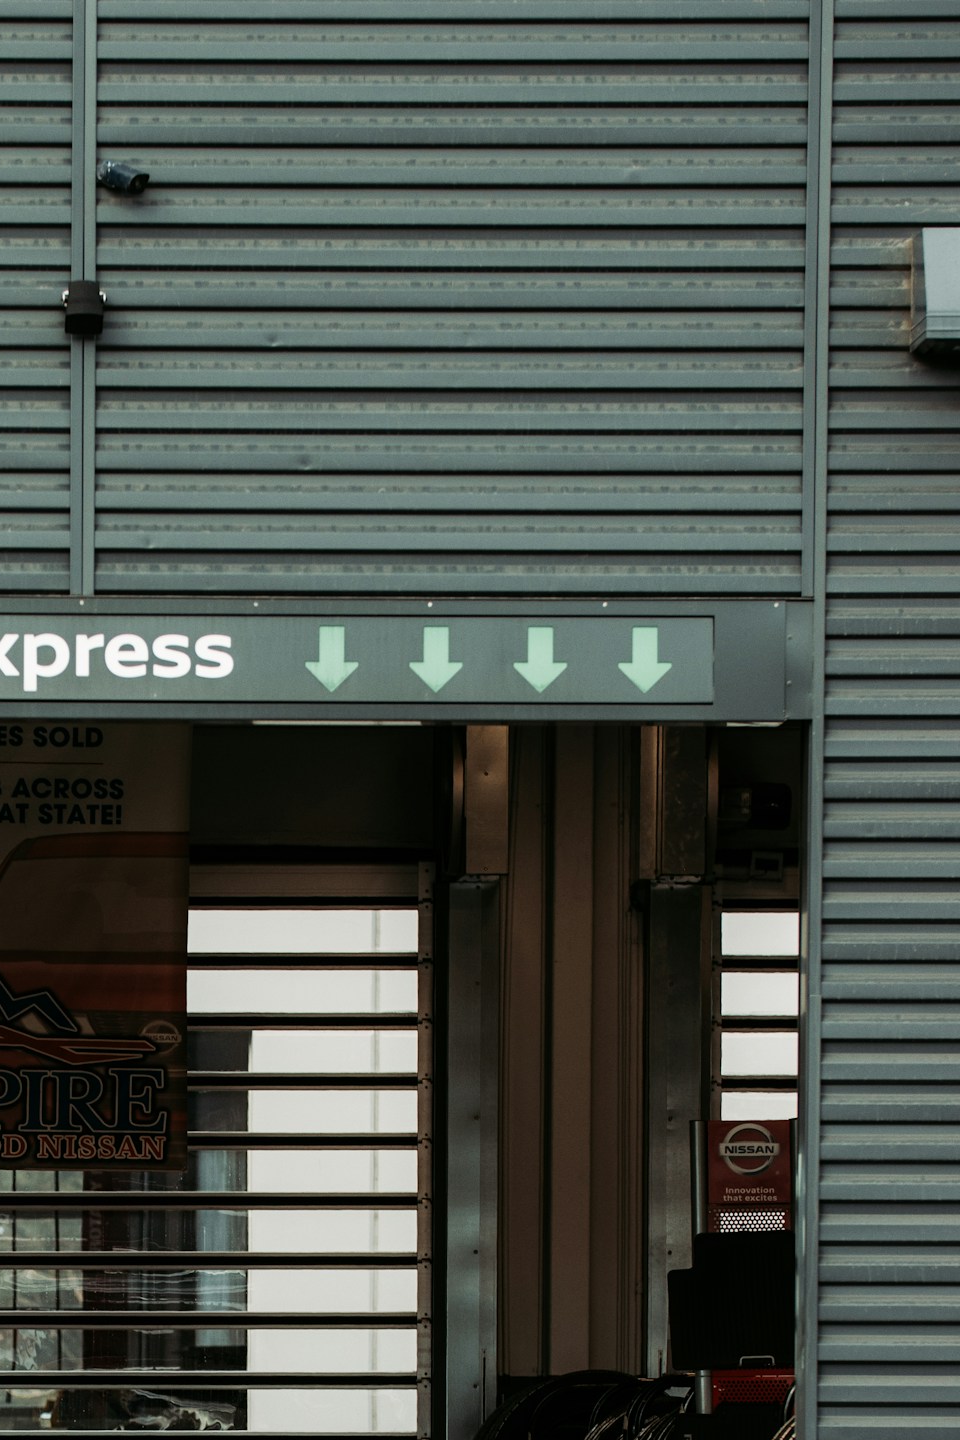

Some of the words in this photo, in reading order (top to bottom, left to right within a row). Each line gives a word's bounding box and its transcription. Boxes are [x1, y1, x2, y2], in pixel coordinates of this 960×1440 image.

[33, 726, 104, 748] SOLD
[11, 777, 124, 800] ACROSS
[38, 804, 122, 825] STATE!
[36, 1135, 167, 1161] NISSAN
[724, 1145, 775, 1154] NISSAN
[723, 1194, 743, 1202] that
[744, 1194, 778, 1202] excites
[725, 1186, 775, 1194] Innovation
